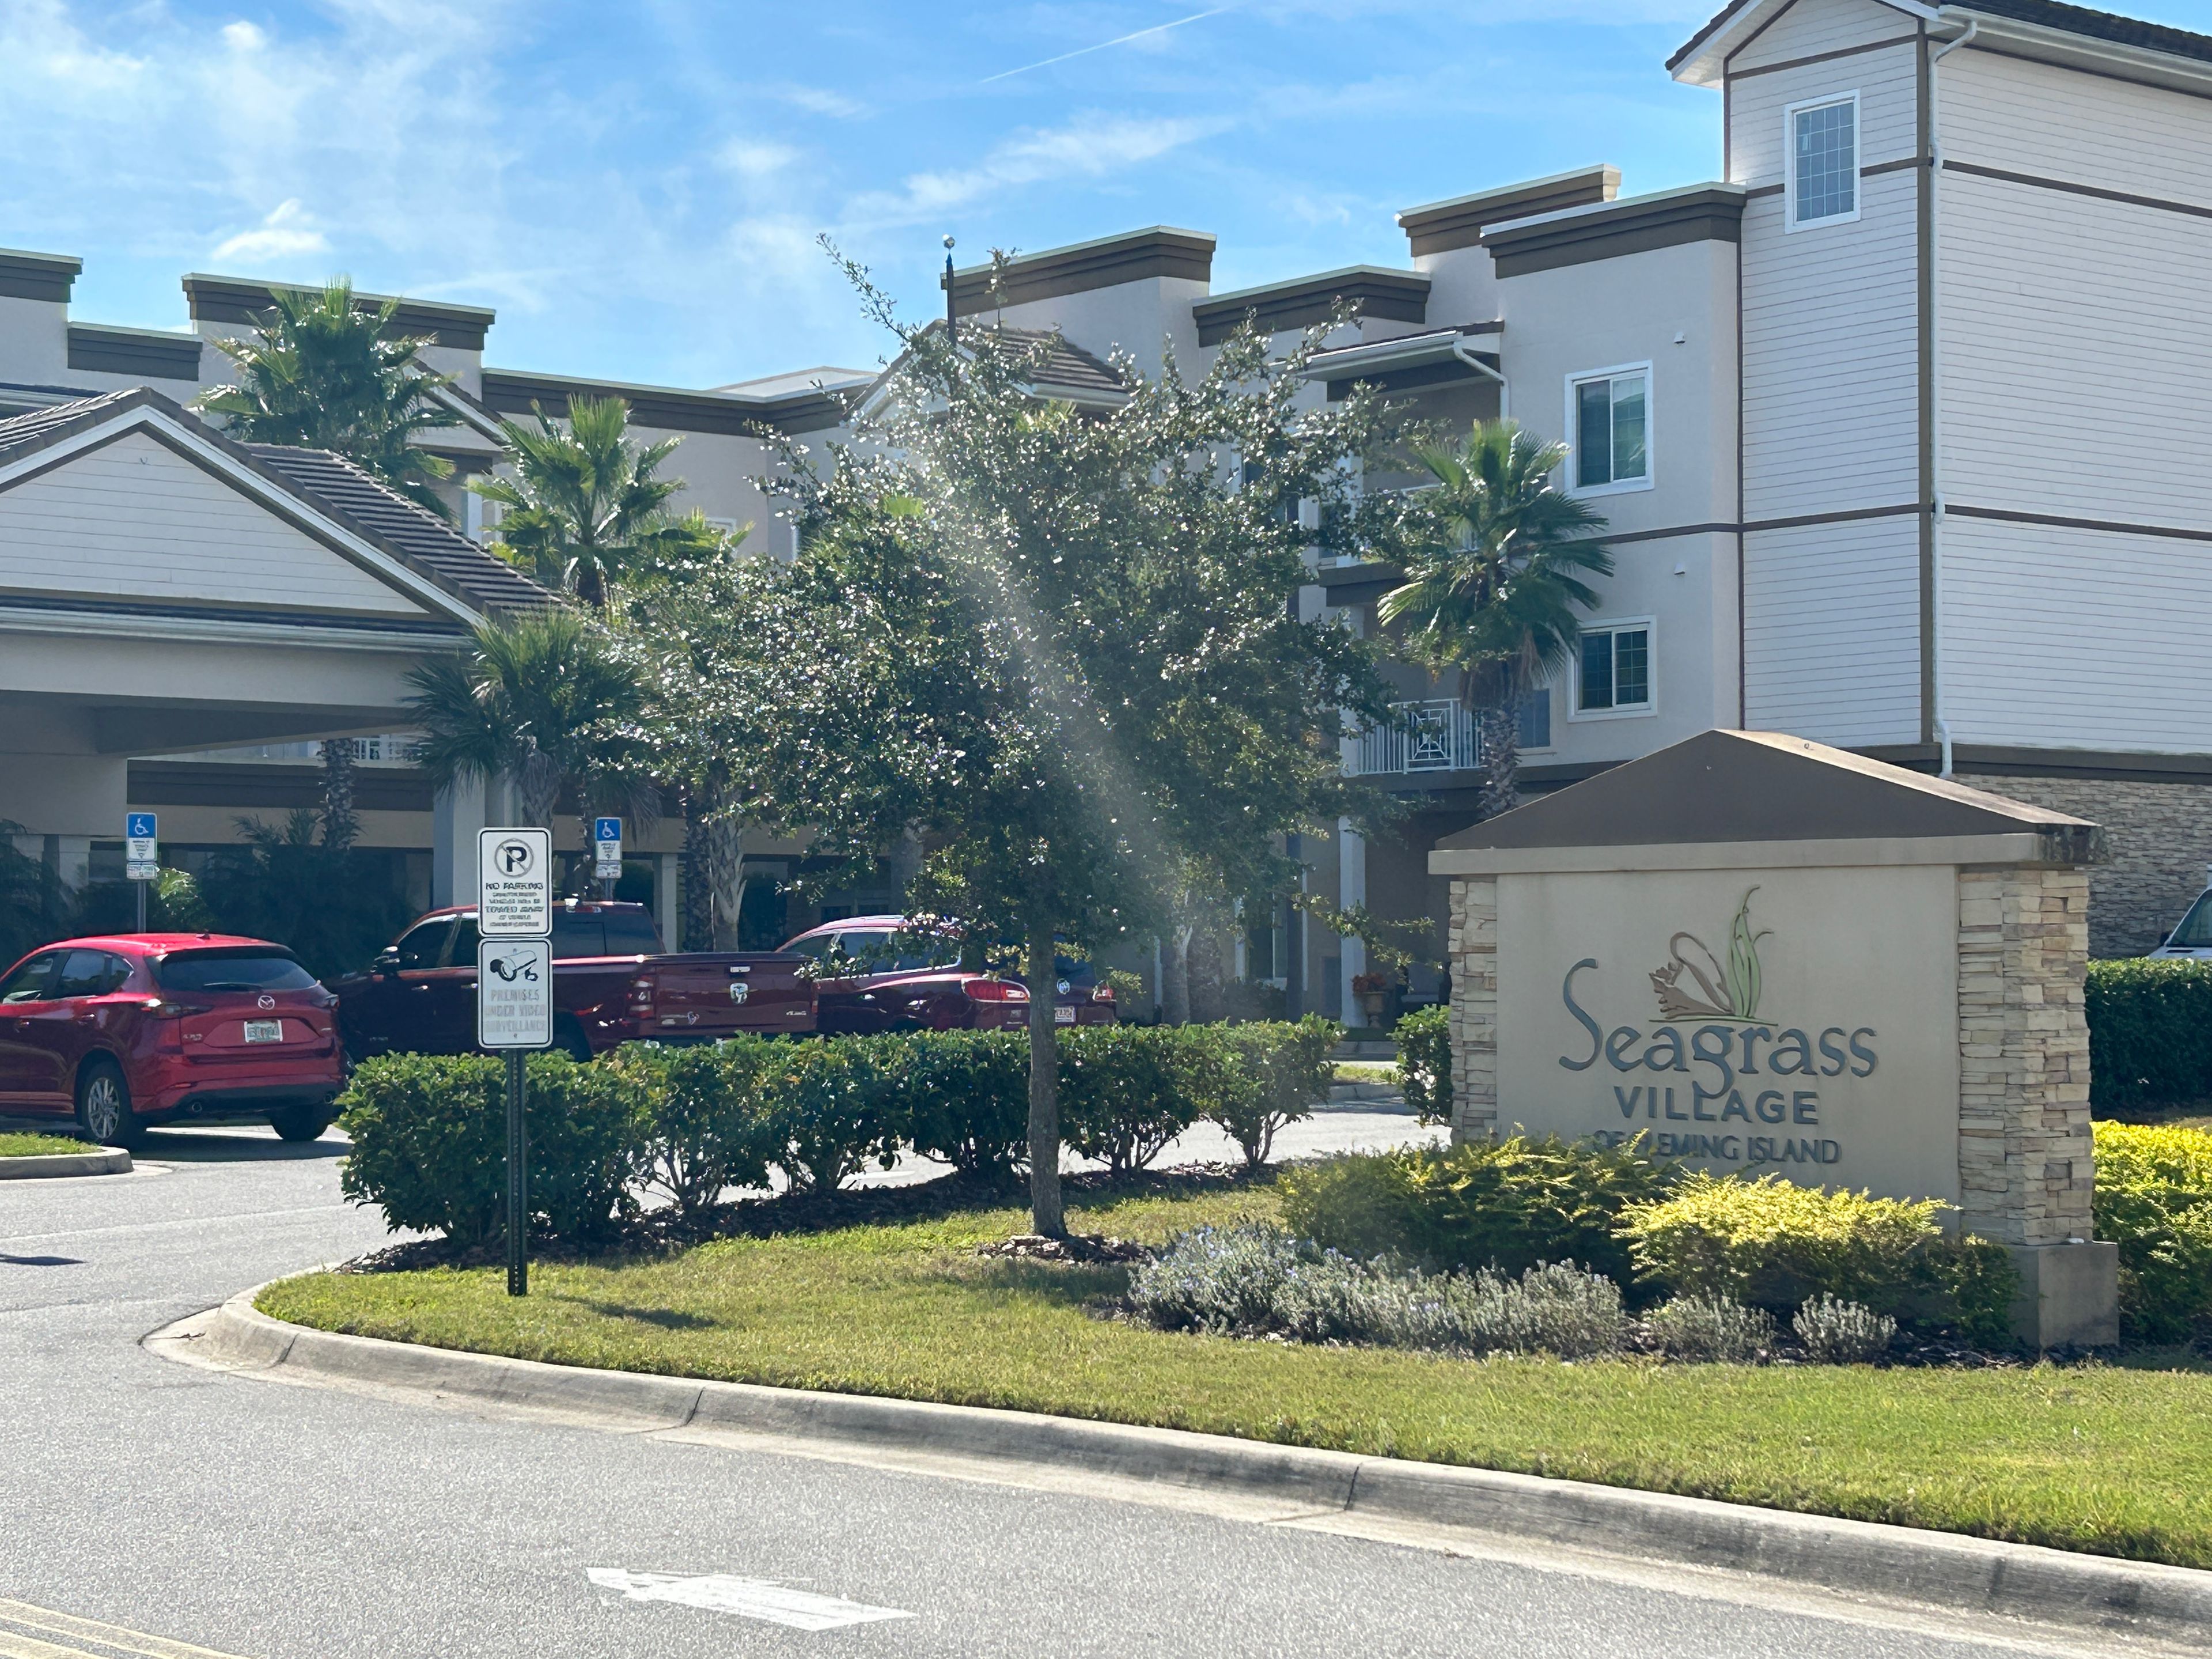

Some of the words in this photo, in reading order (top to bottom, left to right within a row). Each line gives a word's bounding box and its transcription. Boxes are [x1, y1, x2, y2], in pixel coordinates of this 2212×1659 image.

[491, 988, 540, 1002] PREMISES
[1558, 958, 1878, 1100] Seagrass
[1613, 1085, 1819, 1125] VILLAGE
[1747, 1136, 1843, 1164] ISLAND
